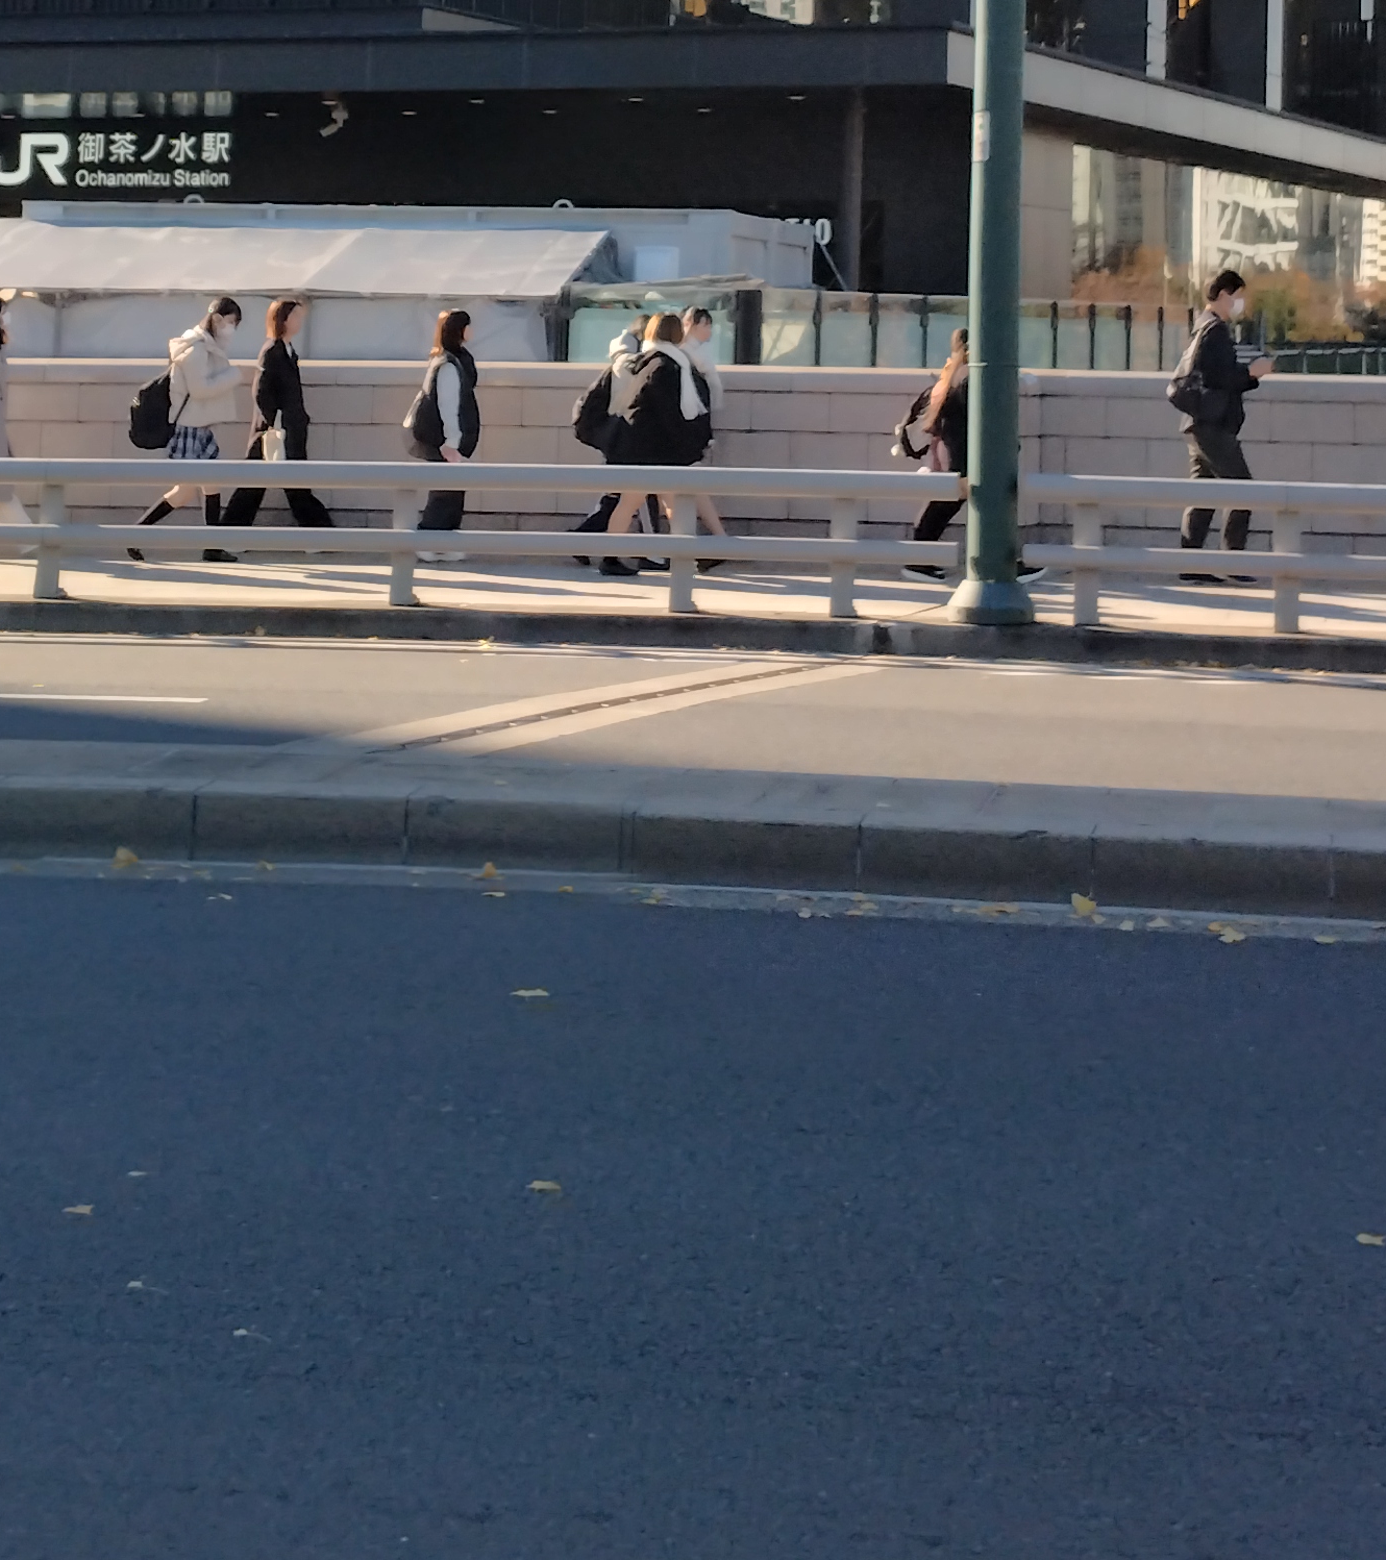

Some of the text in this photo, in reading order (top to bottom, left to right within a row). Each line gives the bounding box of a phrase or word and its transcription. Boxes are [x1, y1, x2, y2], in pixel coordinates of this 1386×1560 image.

[77, 132, 231, 164] 御茶ノ水駅
[75, 169, 231, 188] Ochanomizu Station
